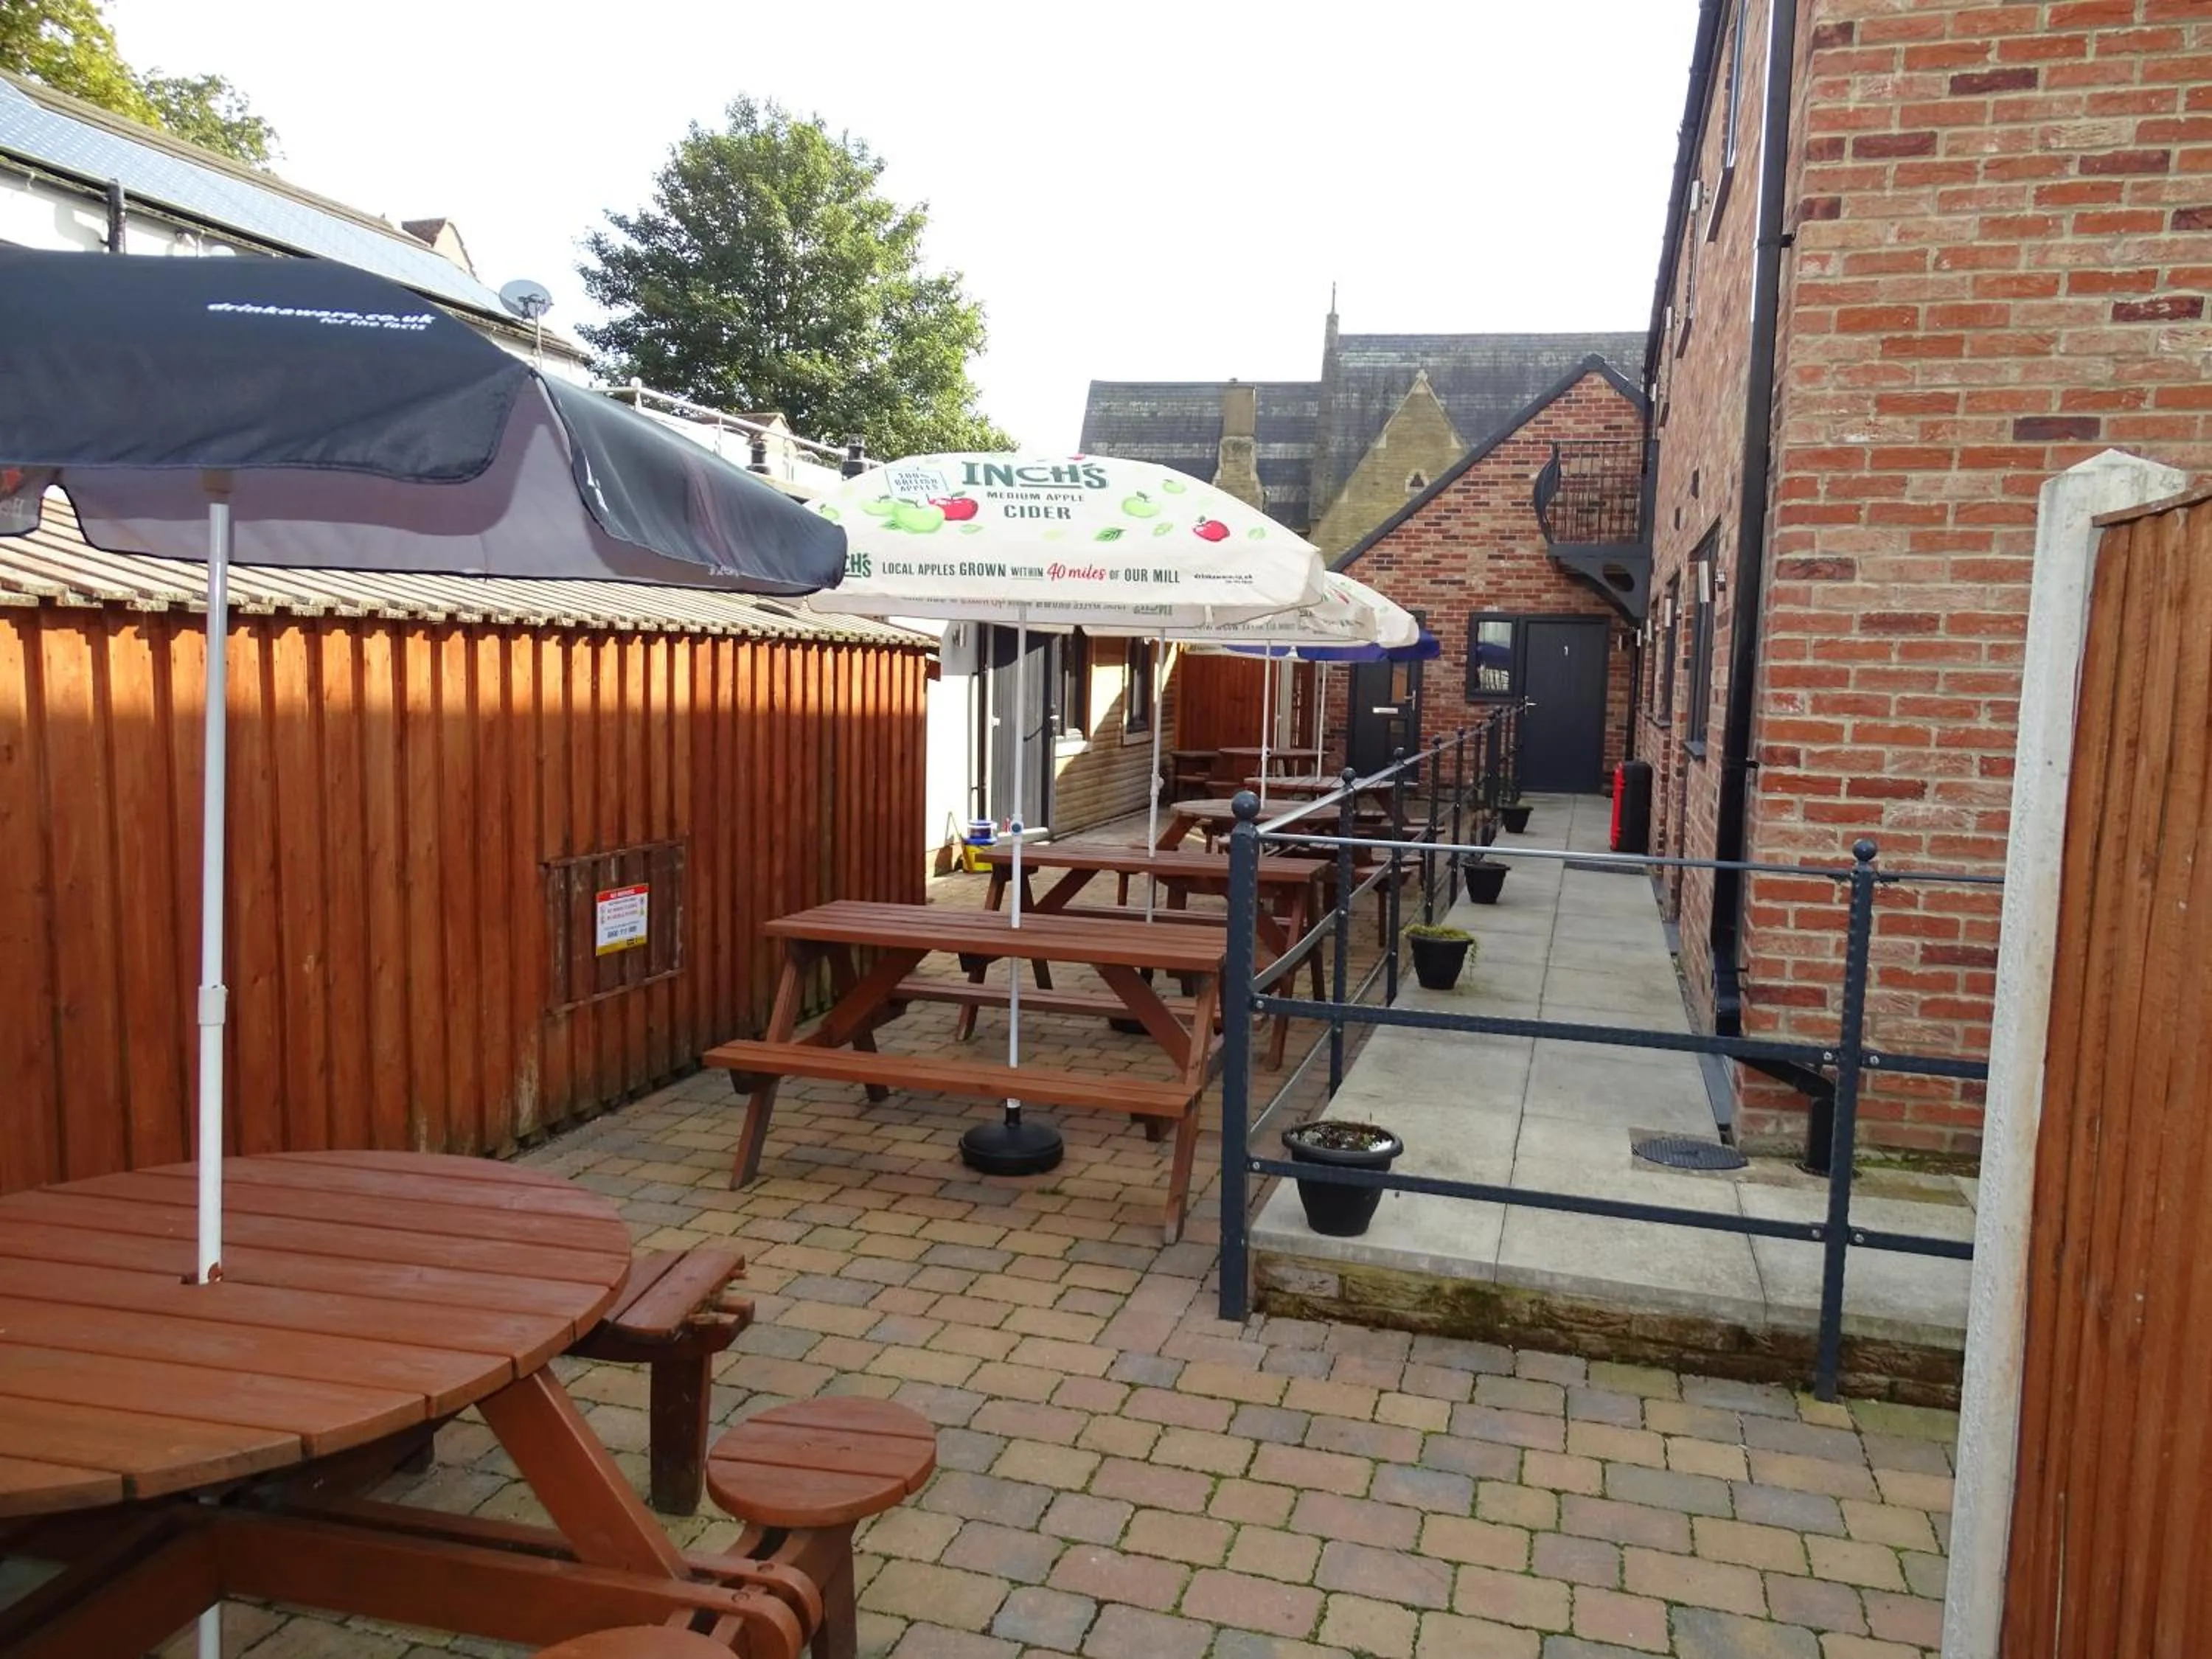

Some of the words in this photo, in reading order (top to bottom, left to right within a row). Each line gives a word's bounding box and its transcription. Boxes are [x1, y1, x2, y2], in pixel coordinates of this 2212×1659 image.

[206, 302, 436, 324] drinkaware.co.uk
[961, 461, 1109, 490] INCH'S
[986, 491, 1041, 501] MEDIUM
[1046, 493, 1085, 502] APPLE
[1004, 504, 1072, 520] CIDER
[882, 561, 915, 575] LOCAL
[918, 563, 956, 577] APPLES
[959, 562, 1007, 577] GROWN
[1011, 566, 1044, 577] WITHIN
[1047, 562, 1065, 581] 40
[1068, 563, 1107, 581] miles
[1124, 568, 1148, 582] OUR
[1152, 568, 1180, 583] MILL
